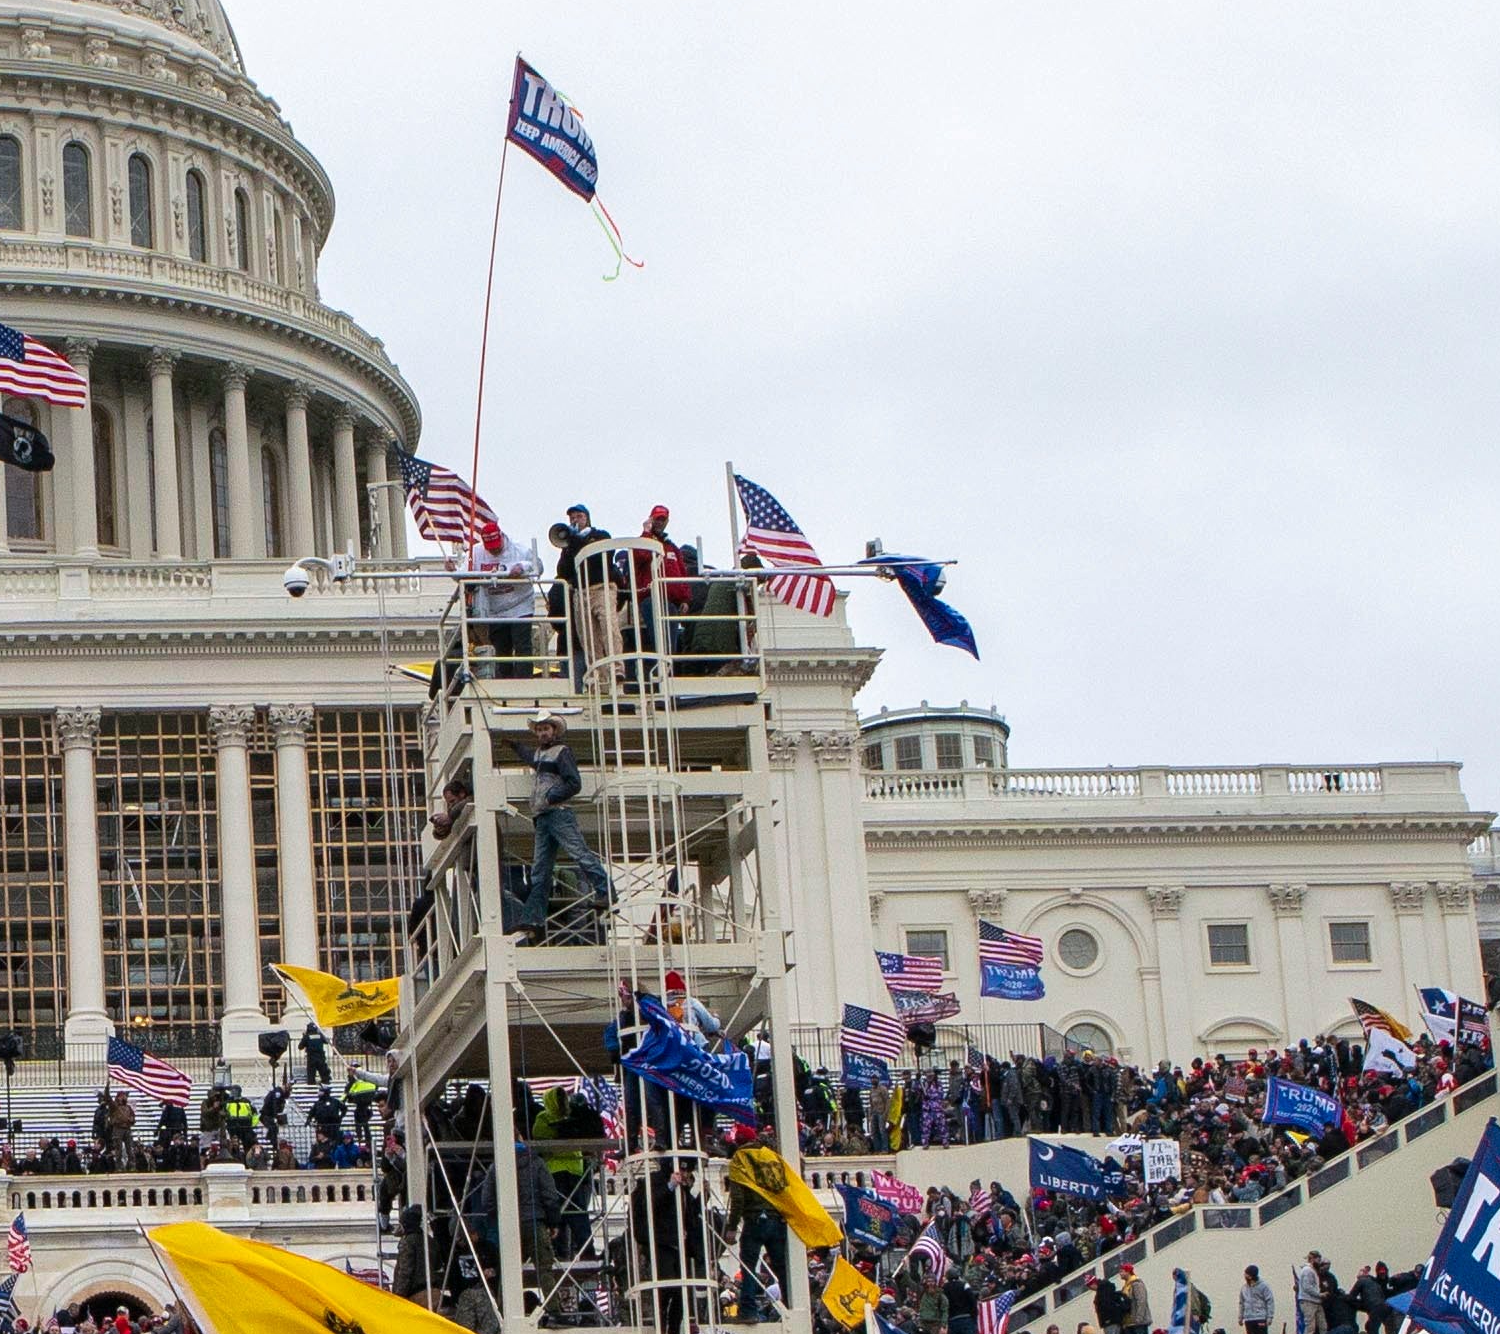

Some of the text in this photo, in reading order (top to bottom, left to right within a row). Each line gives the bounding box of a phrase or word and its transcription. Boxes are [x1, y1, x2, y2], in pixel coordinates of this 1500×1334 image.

[540, 134, 581, 167] AMERICA
[987, 966, 1038, 981] TRUMP
[1278, 1085, 1337, 1113] TRUMP
[1040, 1172, 1100, 1197] LIBERTY
